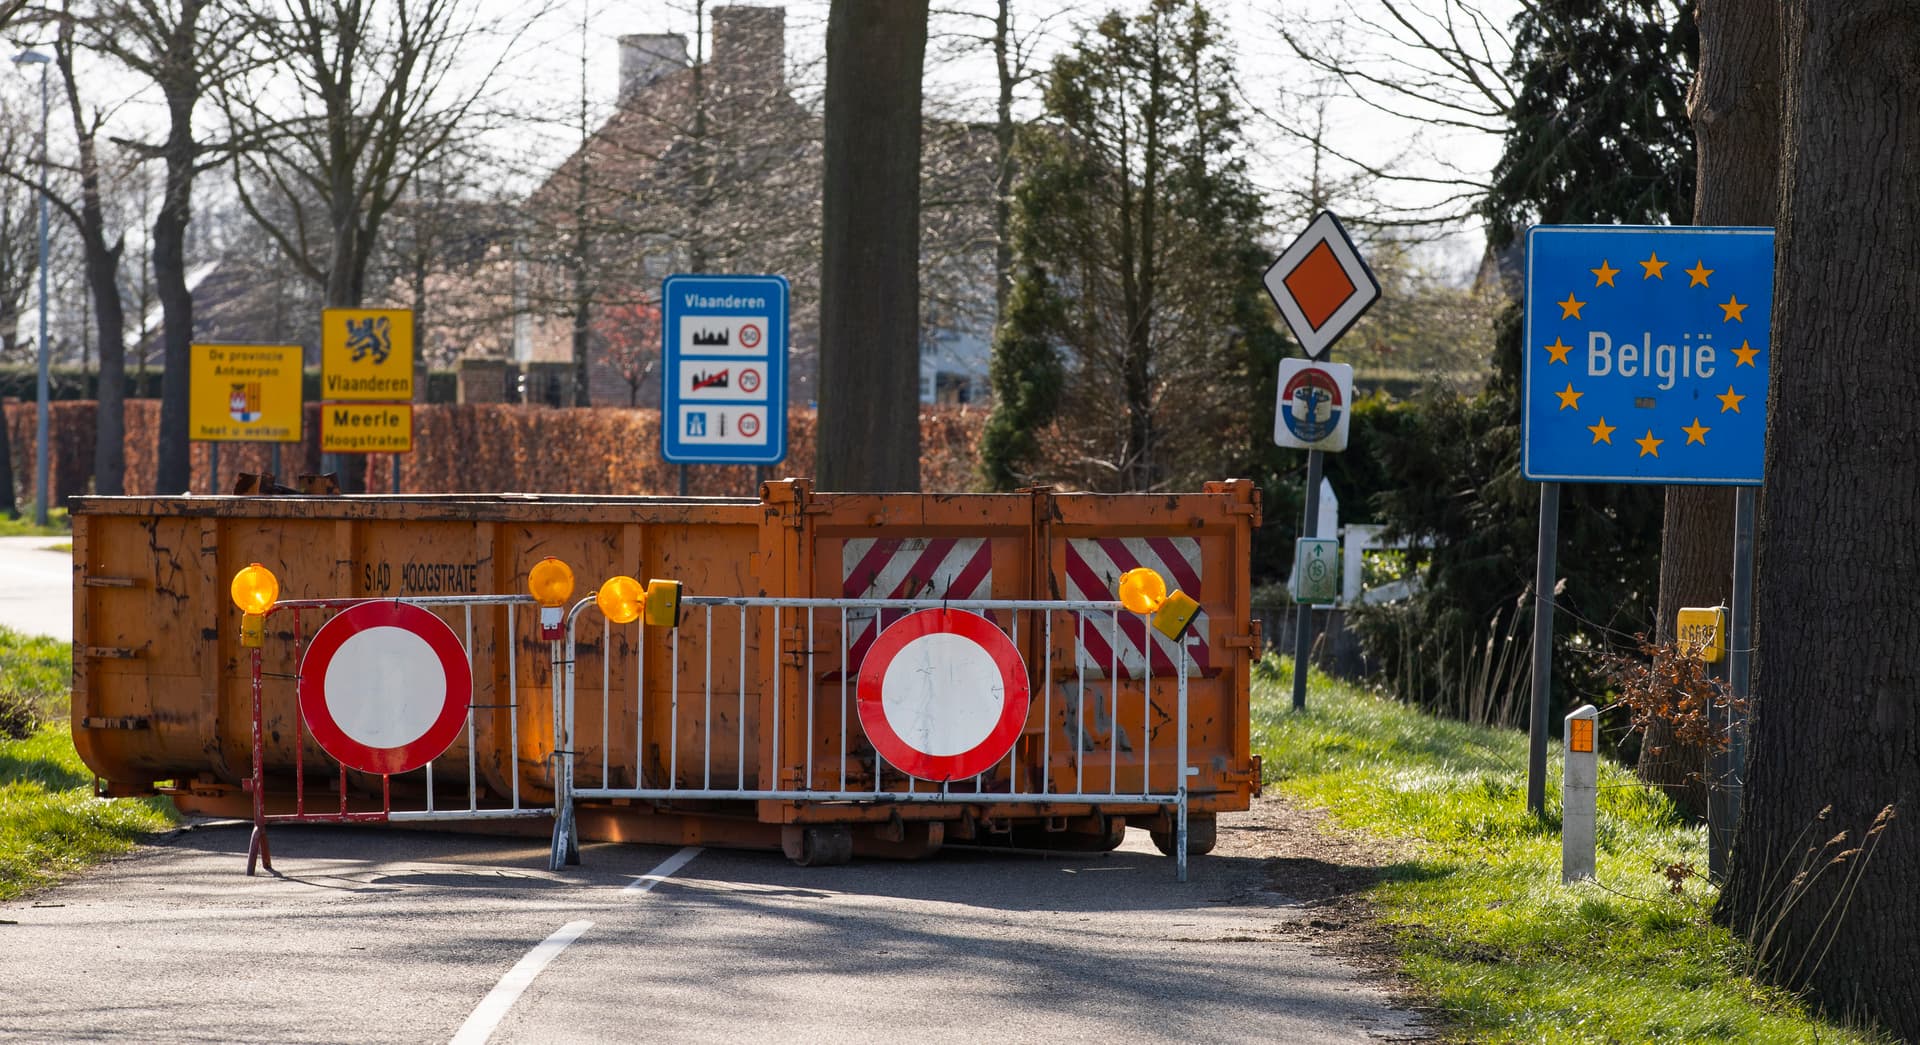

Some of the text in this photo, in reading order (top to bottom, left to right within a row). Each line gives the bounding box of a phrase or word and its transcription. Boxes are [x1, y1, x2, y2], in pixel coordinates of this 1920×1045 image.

[684, 294, 765, 309] Vlaanderen
[743, 331, 757, 342] 50
[208, 349, 284, 362] De provincie
[1587, 331, 1716, 390] België
[214, 365, 279, 378] Antwerpen
[327, 375, 409, 391] Vlaanderen
[743, 375, 757, 386] 70
[333, 409, 399, 427] Meerle
[325, 434, 408, 448] Hoogstraten
